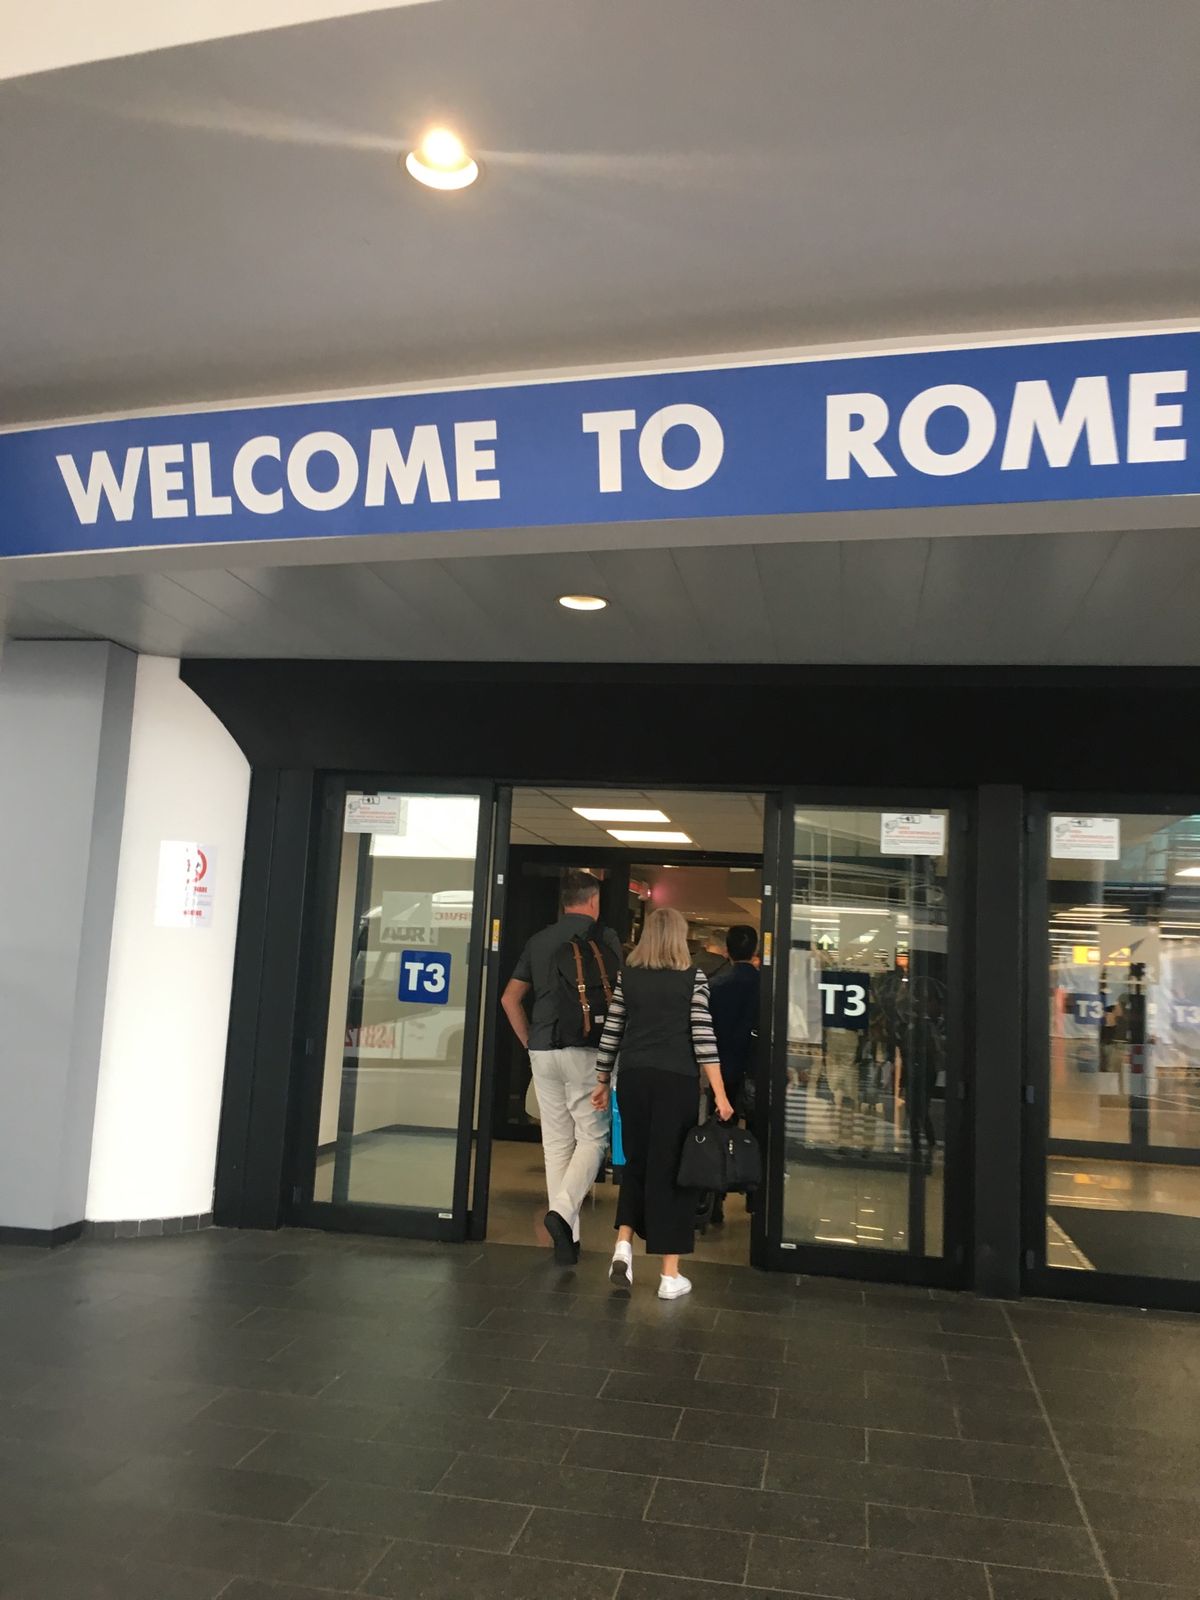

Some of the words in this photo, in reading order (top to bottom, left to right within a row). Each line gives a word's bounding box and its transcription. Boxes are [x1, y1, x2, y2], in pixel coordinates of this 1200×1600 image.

[56, 420, 500, 524] WELCOME
[582, 403, 724, 492] TO
[826, 370, 1187, 480] ROME
[404, 961, 446, 993] T3
[817, 983, 867, 1017] T3
[1076, 1000, 1104, 1019] T3
[1173, 1004, 1200, 1024] T3
